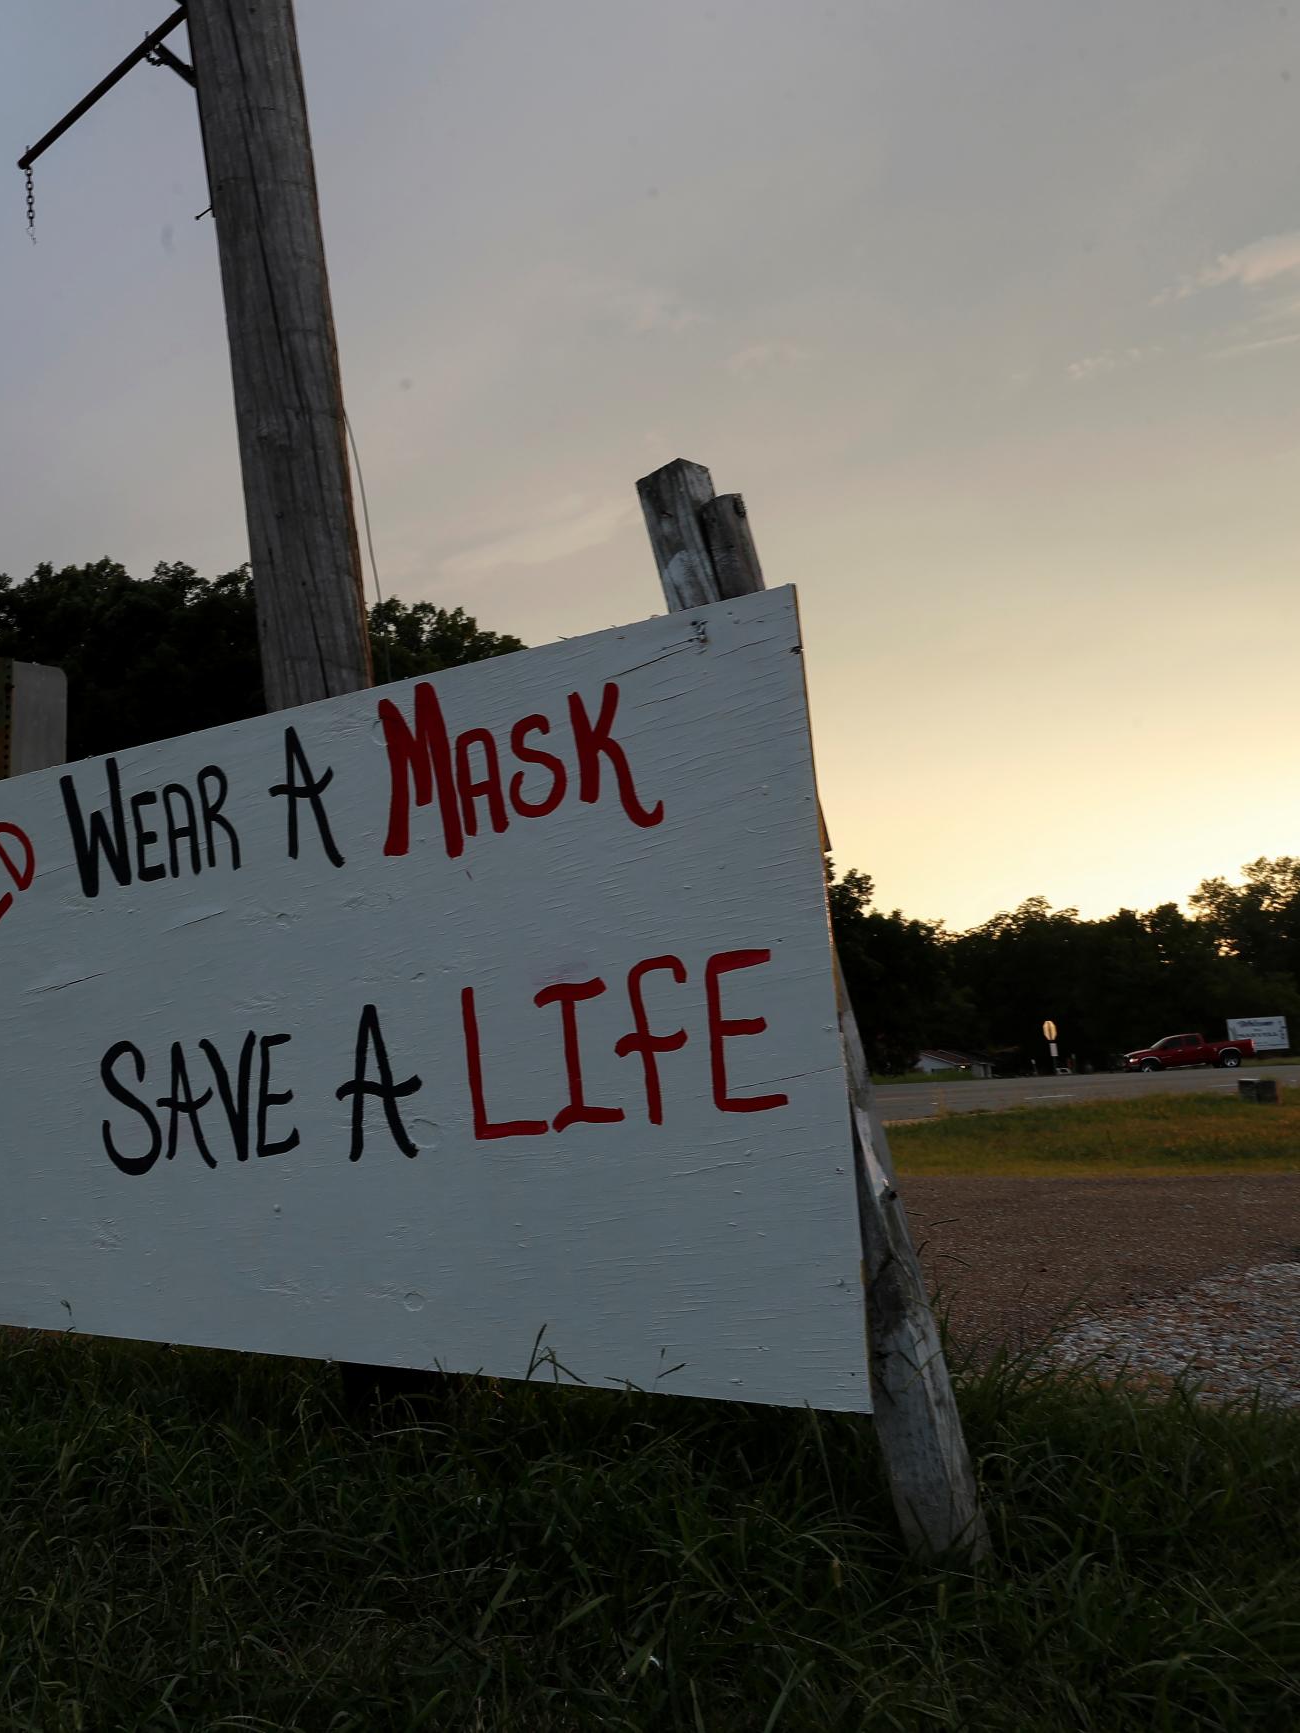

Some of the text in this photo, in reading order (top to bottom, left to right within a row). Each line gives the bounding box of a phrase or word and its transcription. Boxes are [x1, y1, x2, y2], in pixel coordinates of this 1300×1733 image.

[59, 682, 664, 898] WEAR A MASK
[100, 949, 789, 1176] SAVE A LIFE
